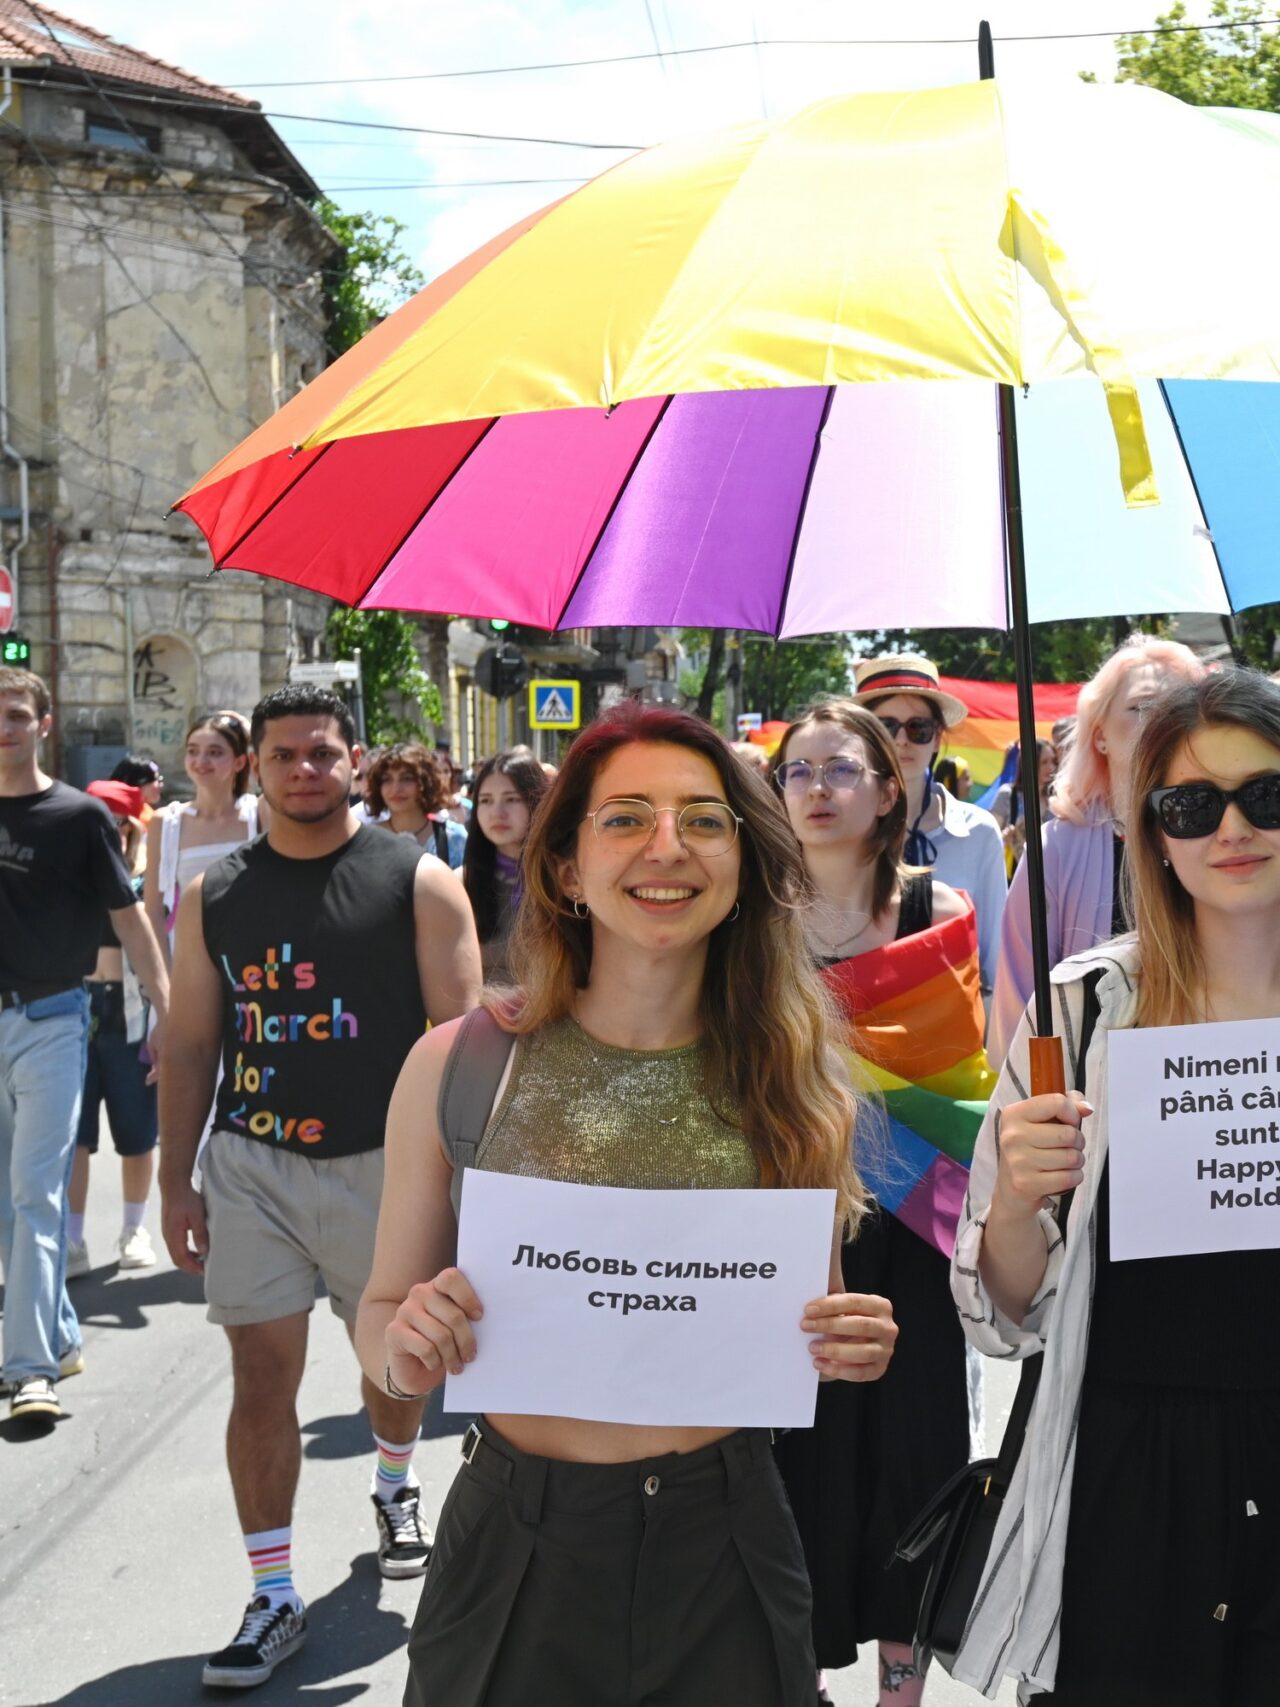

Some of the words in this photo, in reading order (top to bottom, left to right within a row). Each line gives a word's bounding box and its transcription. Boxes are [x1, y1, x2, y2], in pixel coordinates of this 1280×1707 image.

[5, 643, 28, 660] 21
[221, 943, 316, 991] Let's
[234, 998, 357, 1043] March
[233, 1051, 276, 1093] for
[1164, 1050, 1267, 1080] Nimeni
[1160, 1087, 1234, 1121] până
[228, 1101, 325, 1144] Love
[1215, 1121, 1280, 1147] sunt
[511, 1244, 638, 1276] Любовь
[645, 1260, 777, 1280] сильнее
[587, 1290, 697, 1316] страха
